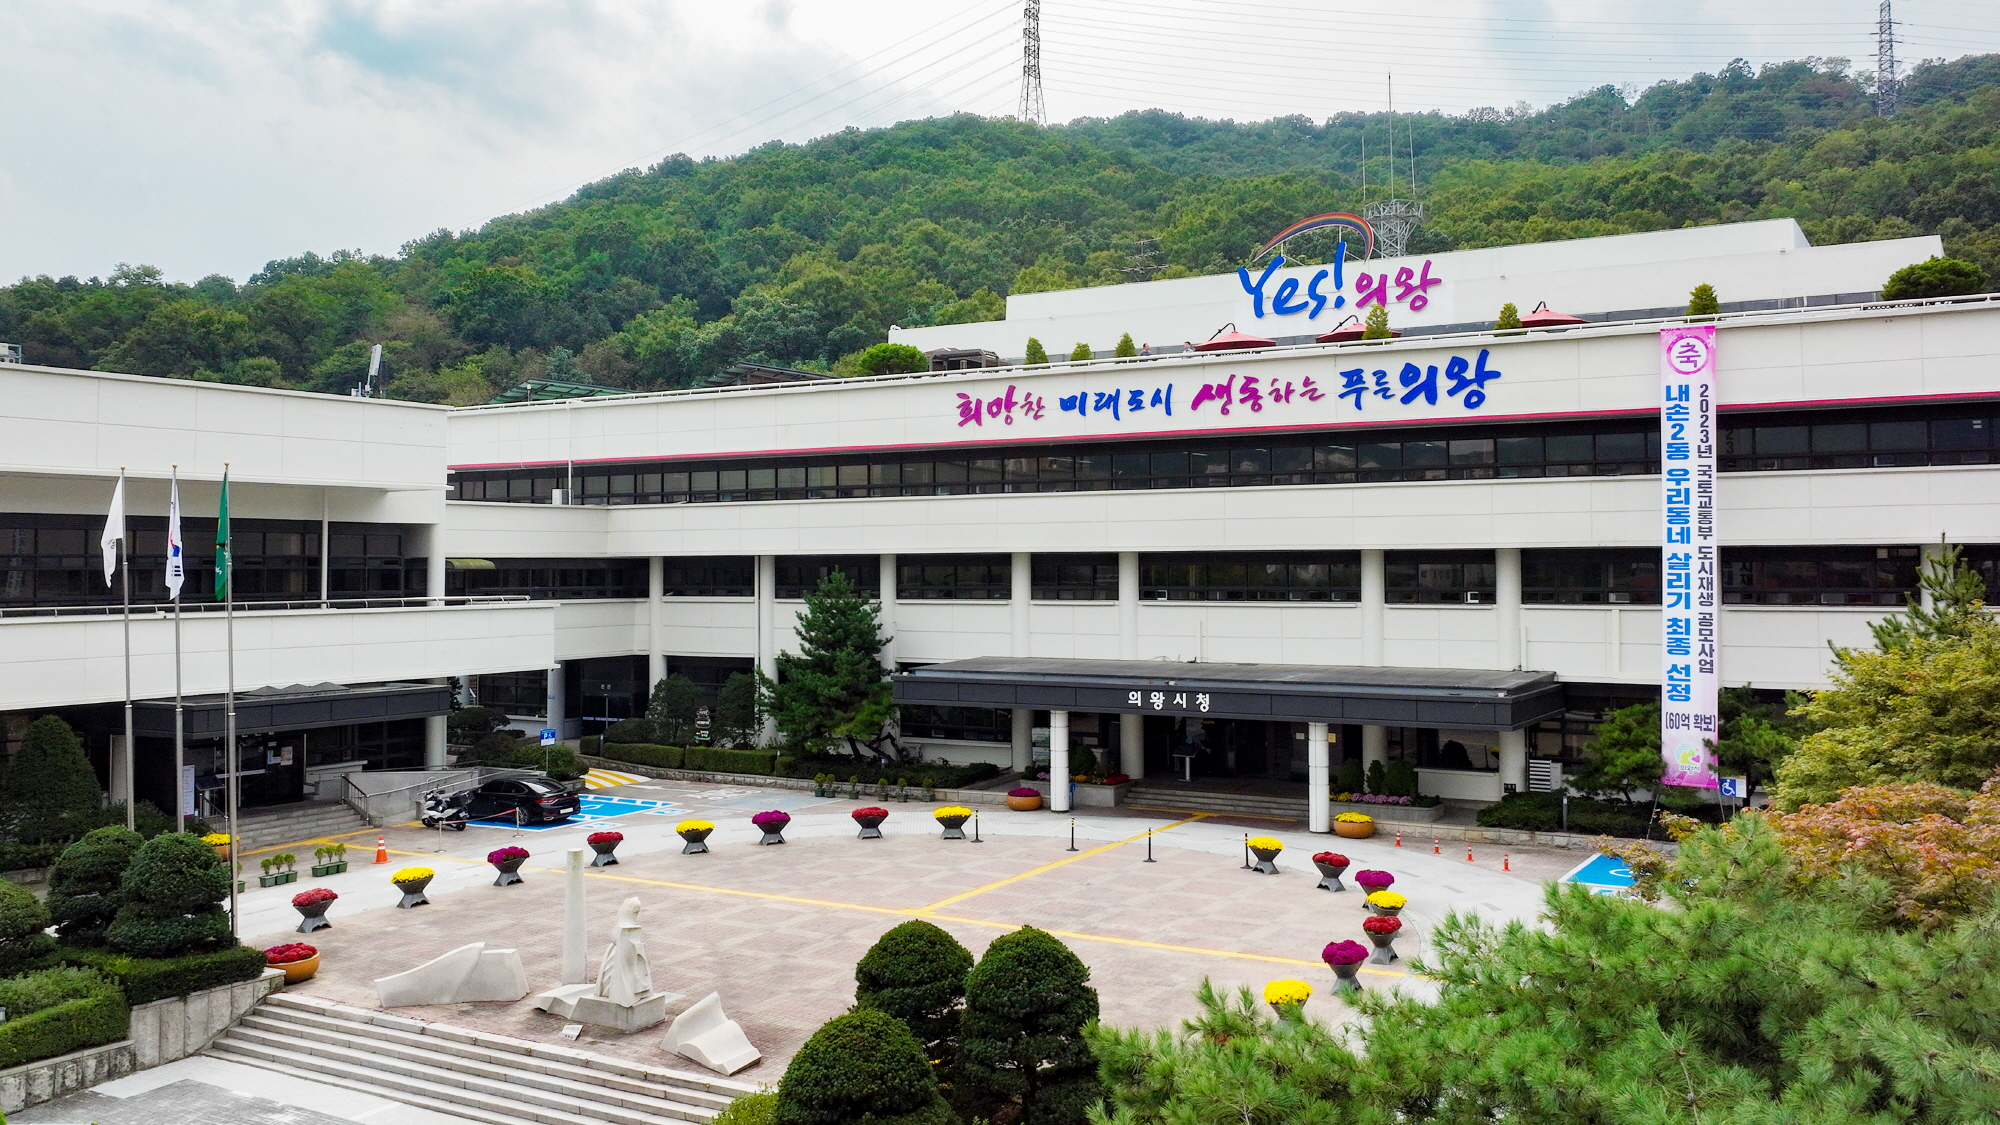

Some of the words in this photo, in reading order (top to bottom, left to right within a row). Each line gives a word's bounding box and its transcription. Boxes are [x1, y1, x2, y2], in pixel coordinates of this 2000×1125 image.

[1237, 240, 1346, 320] Yes!
[1355, 259, 1442, 312] 의왕
[1675, 341, 1702, 369] 축
[956, 385, 1046, 427] 희망찬
[1059, 383, 1173, 421] 미래도시
[1190, 374, 1326, 416] 생동하는
[1665, 384, 1690, 461] 내손2동
[1697, 383, 1713, 459] 2023년
[1666, 468, 1691, 545] 우리동네
[1697, 464, 1713, 541] 국토교통부
[1666, 552, 1692, 610] 살리기
[1697, 545, 1714, 607] 도시재생
[1666, 617, 1691, 656] 최종
[1698, 612, 1715, 674] 공모사업
[1128, 691, 1210, 712] 의왕시청
[1666, 663, 1691, 703] 선정
[1680, 764, 1700, 775] 의왕시
